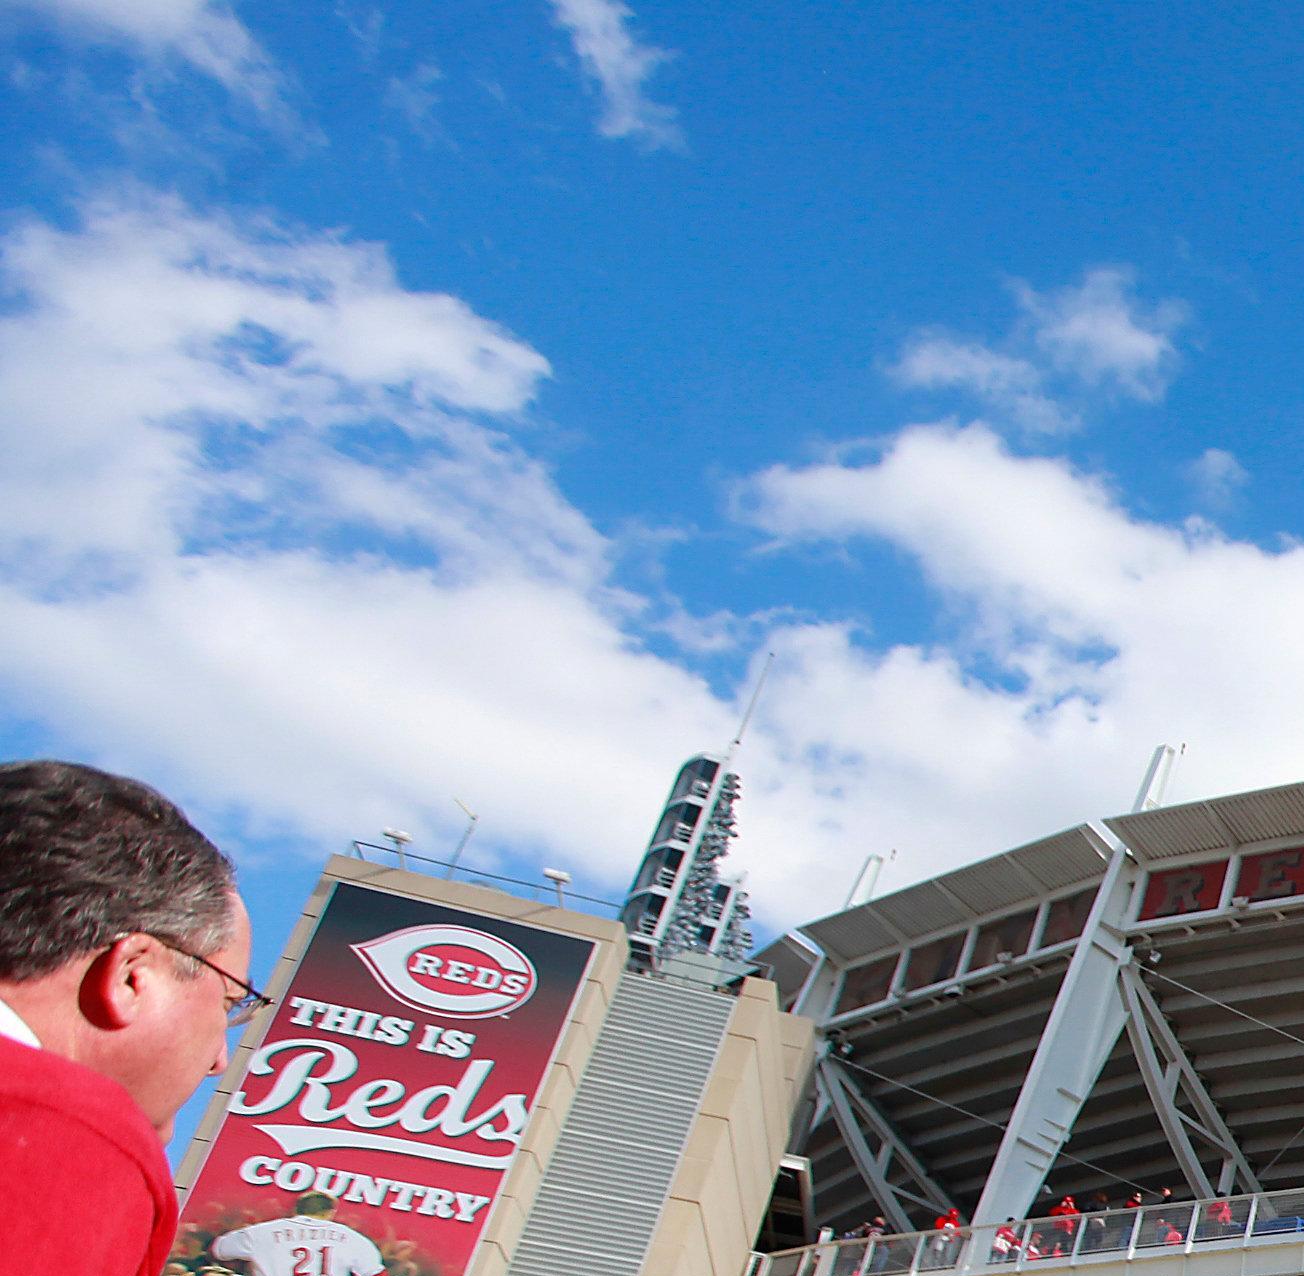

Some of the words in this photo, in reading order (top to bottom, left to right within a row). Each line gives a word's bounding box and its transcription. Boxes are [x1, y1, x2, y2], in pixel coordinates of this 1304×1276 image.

[410, 952, 530, 995] REDS
[289, 997, 415, 1046] THIS
[416, 1025, 477, 1059] IS
[228, 1038, 529, 1144] Reds
[239, 1155, 490, 1223] COUNTRY
